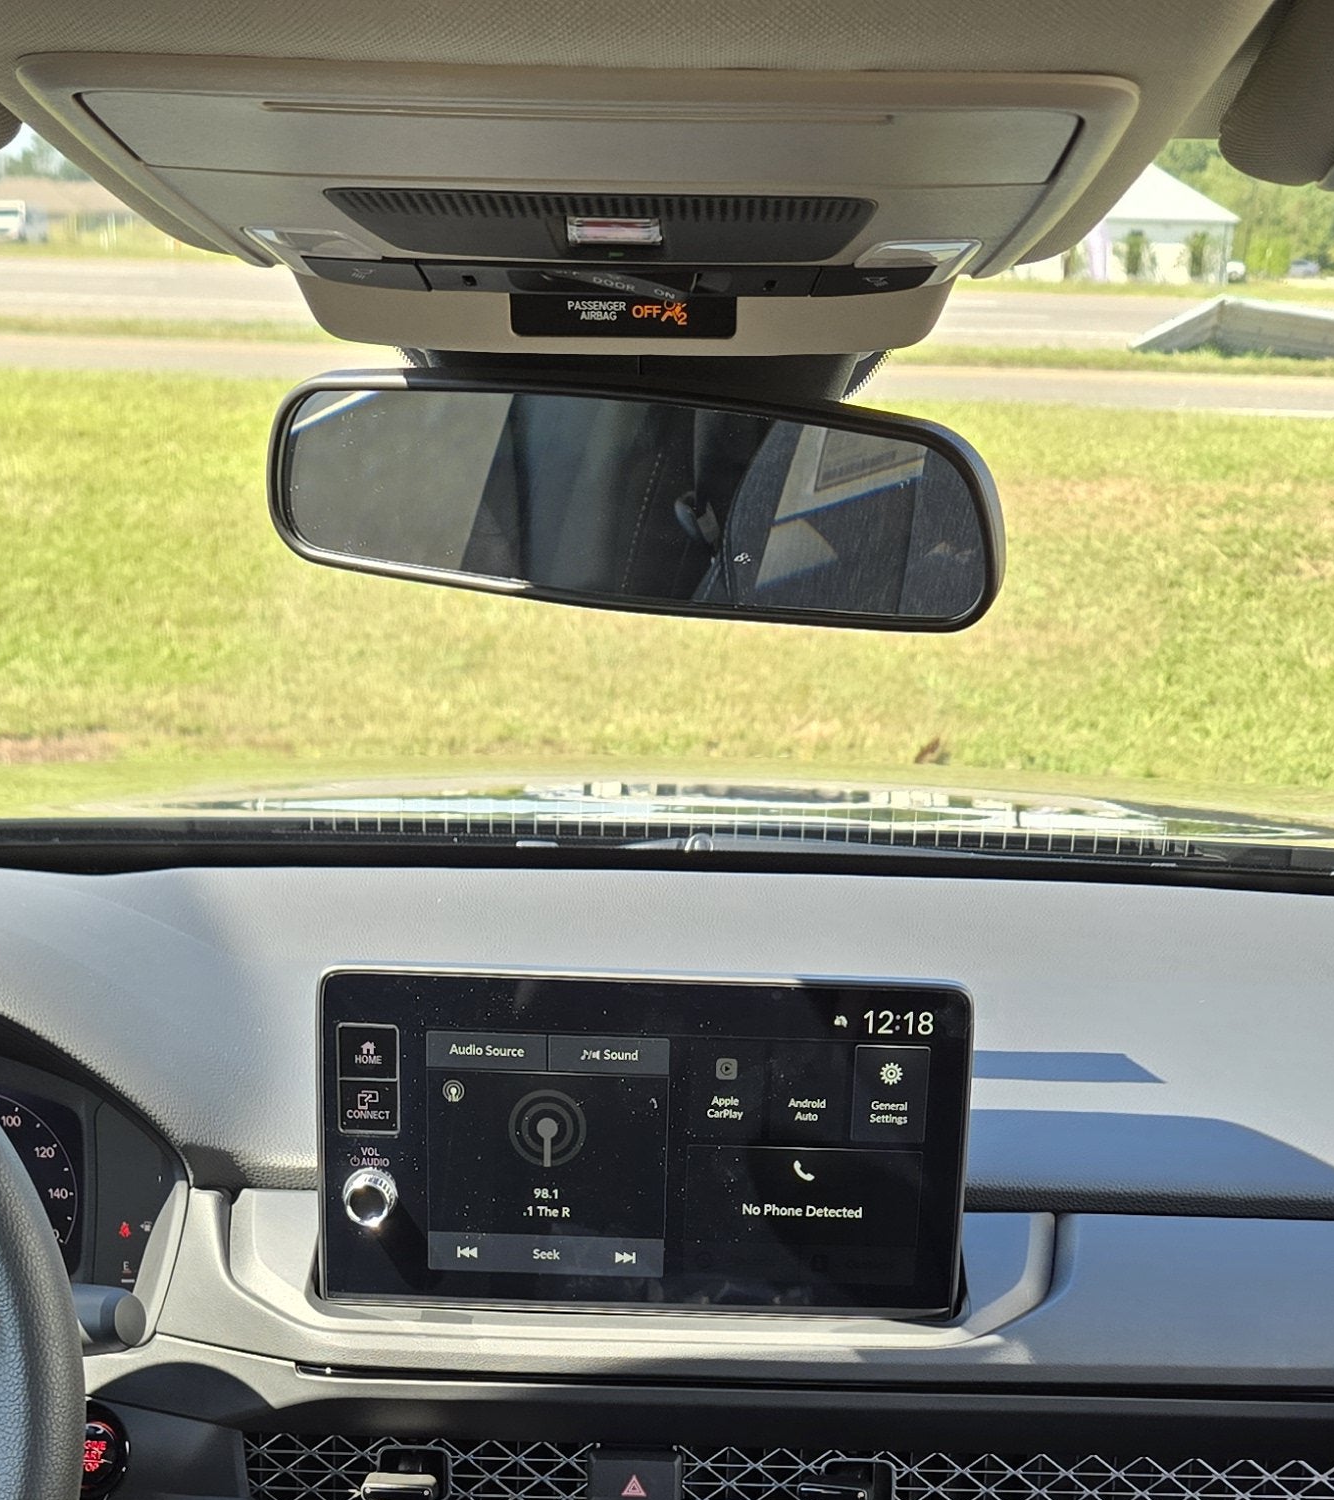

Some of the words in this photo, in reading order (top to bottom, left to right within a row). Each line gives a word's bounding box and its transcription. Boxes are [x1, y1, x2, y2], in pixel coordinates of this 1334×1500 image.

[592, 276, 636, 292] DOOR
[653, 288, 676, 300] ON
[567, 300, 627, 311] PASSENGER
[580, 311, 617, 321] AIRBAG
[631, 305, 662, 319] OFF
[863, 1010, 934, 1036] 12:18
[449, 1043, 483, 1056] Audio
[485, 1045, 525, 1058] Source
[603, 1049, 639, 1062] Sound
[354, 1054, 383, 1065] HOME
[710, 1095, 740, 1107] Apple
[787, 1098, 827, 1109] Android
[870, 1100, 908, 1112] General
[346, 1109, 390, 1120] CONNECT
[706, 1108, 744, 1121] CarPlay
[794, 1111, 819, 1122] Auto
[869, 1113, 908, 1125] Settings
[1, 1115, 21, 1128] 100
[34, 1146, 55, 1159] 120
[360, 1147, 380, 1157] VOL
[360, 1158, 390, 1167] AUDIO
[48, 1187, 68, 1200] 140
[533, 1188, 559, 1200] 98.1
[537, 1205, 559, 1217] The
[561, 1206, 571, 1218] R
[741, 1203, 762, 1216] No
[763, 1204, 803, 1217] Phone
[805, 1205, 863, 1219] Detected
[532, 1248, 560, 1261] Seek
[84, 1440, 107, 1450] GINE
